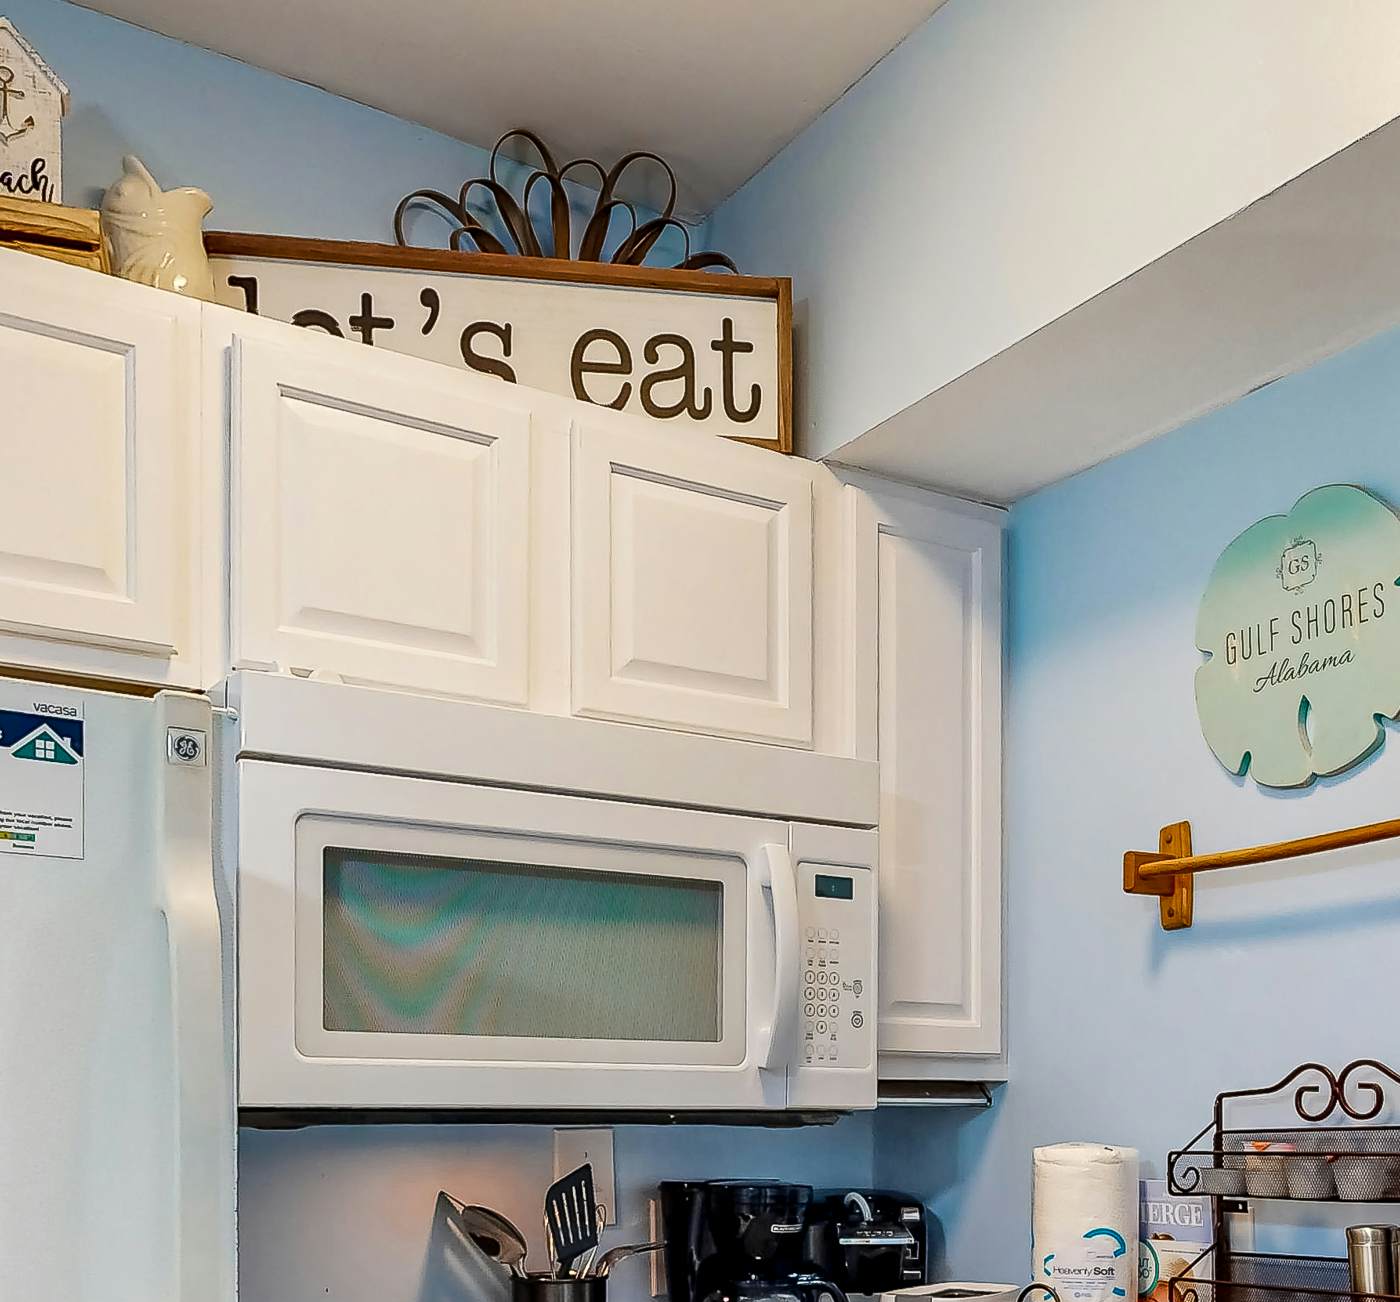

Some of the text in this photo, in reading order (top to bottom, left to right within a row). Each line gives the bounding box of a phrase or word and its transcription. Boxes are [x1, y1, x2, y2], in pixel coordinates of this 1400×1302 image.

[570, 316, 762, 423] eat
[1288, 555, 1310, 575] GS
[1225, 582, 1386, 666] GULF SHORES
[1252, 649, 1356, 693] Alabama
[32, 702, 78, 717] vacasa
[1093, 1266, 1116, 1276] Soft
